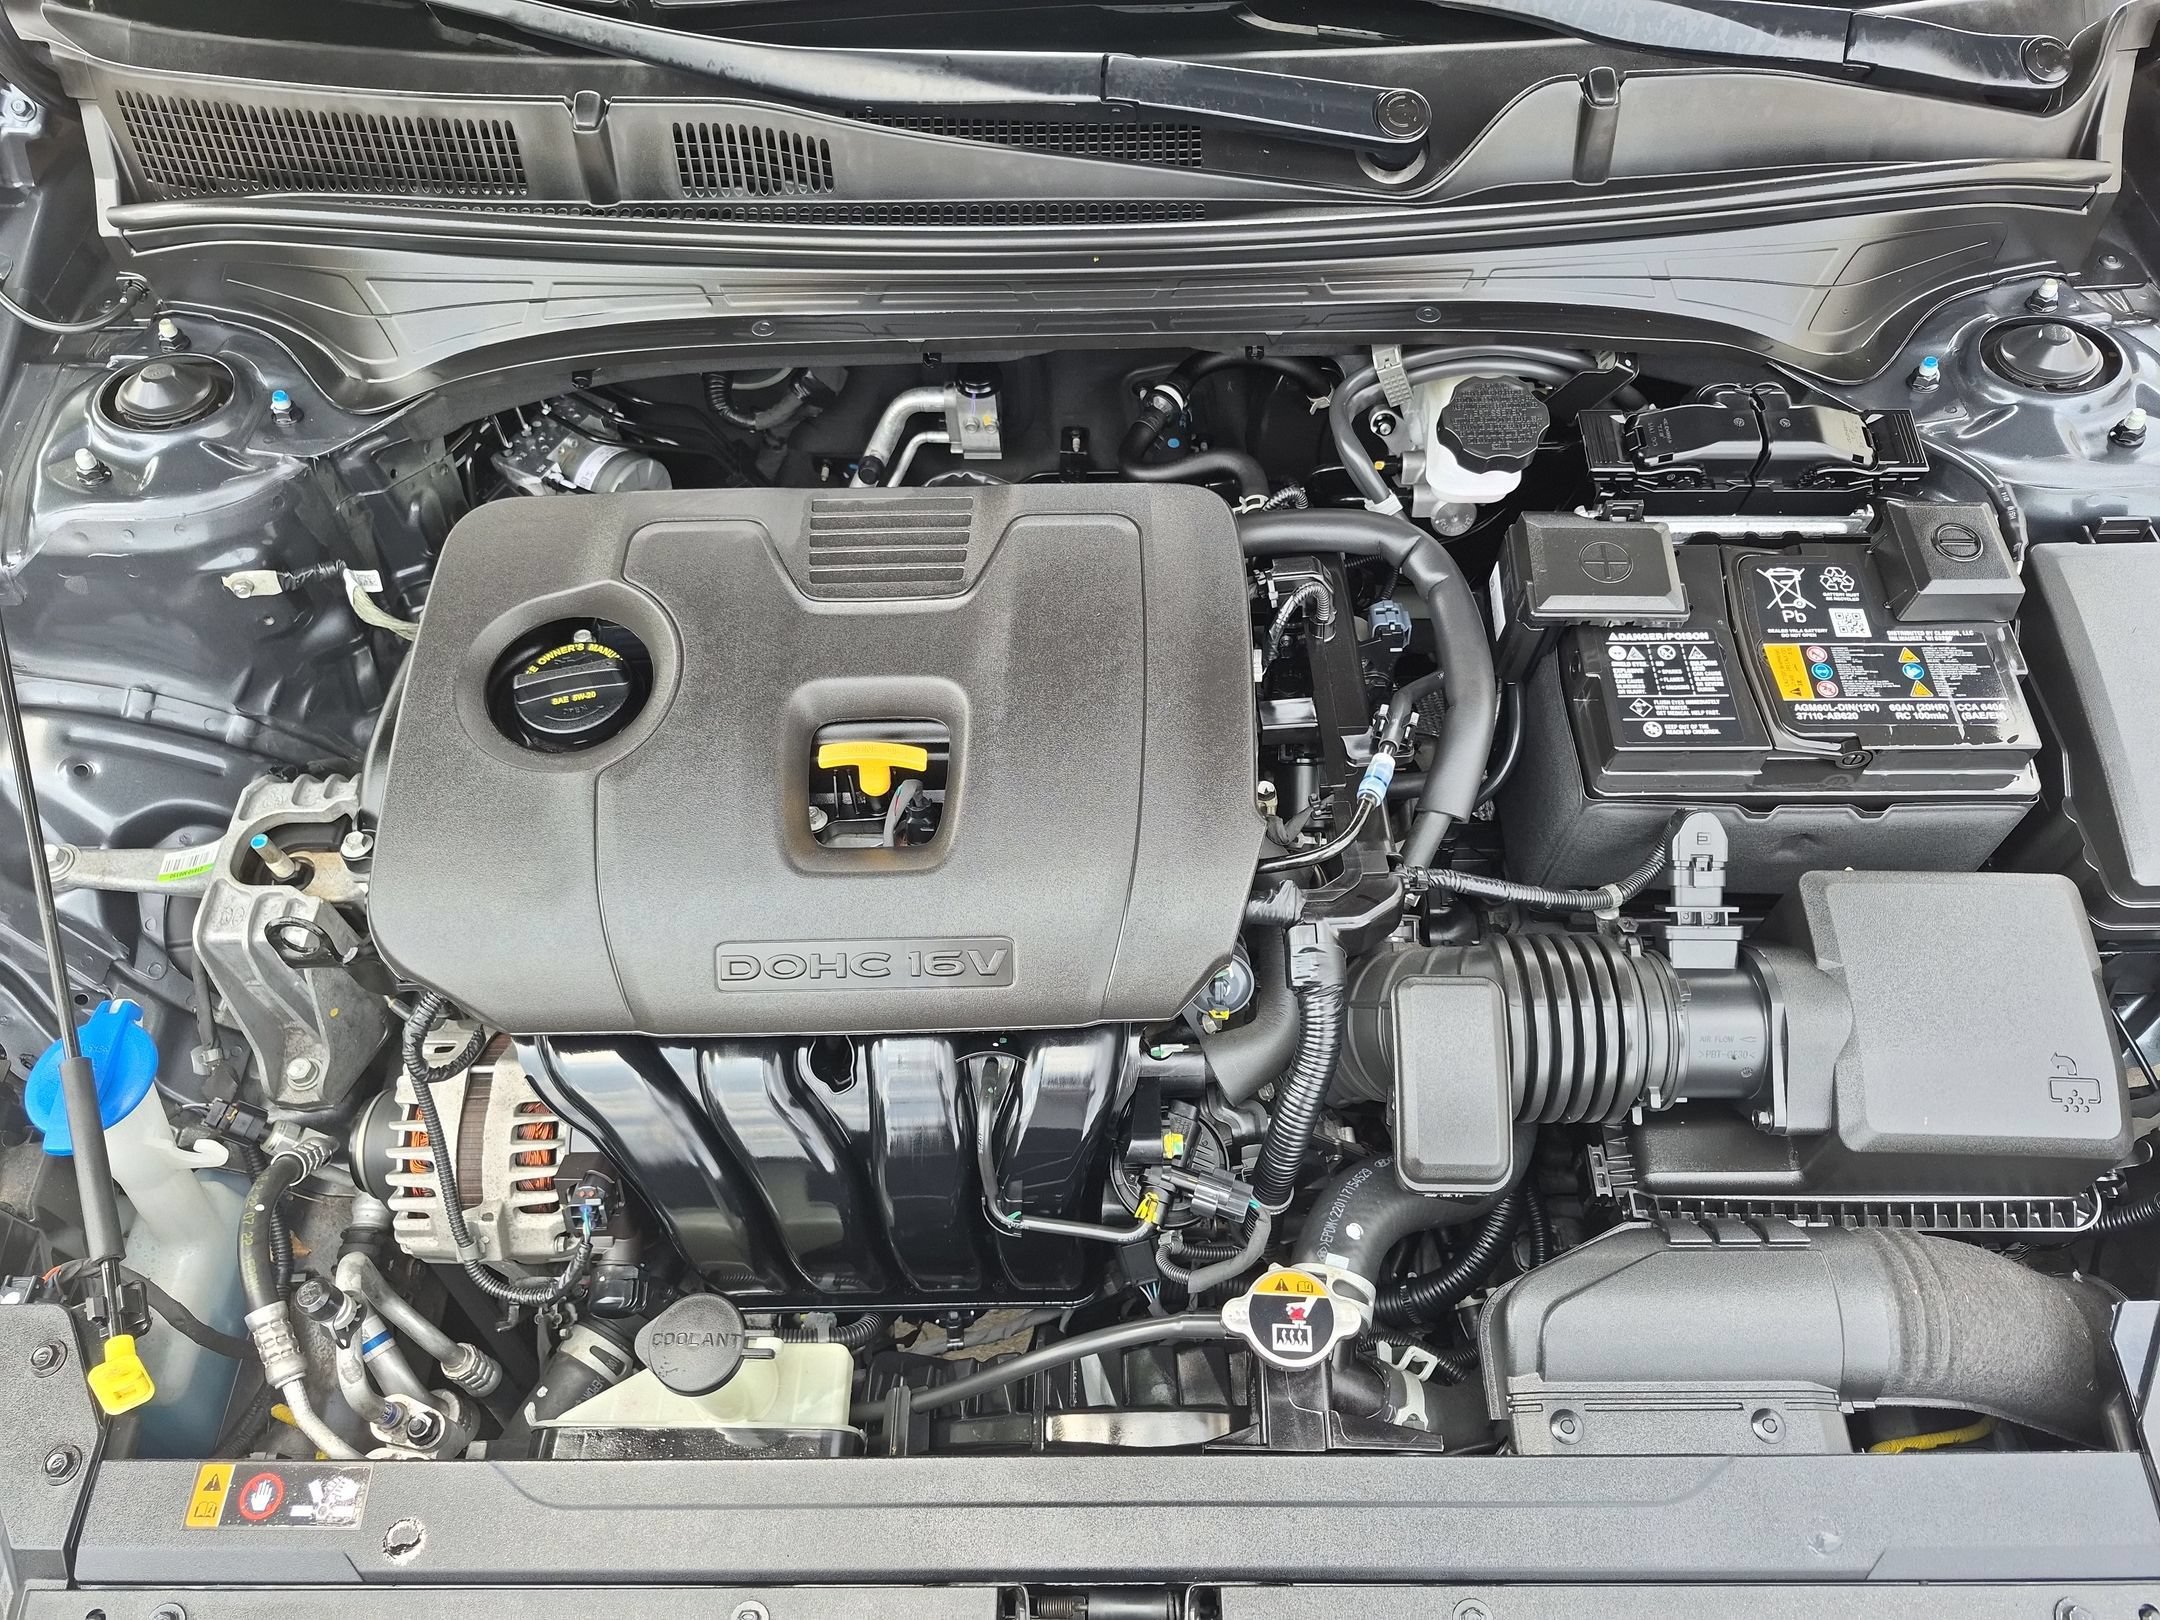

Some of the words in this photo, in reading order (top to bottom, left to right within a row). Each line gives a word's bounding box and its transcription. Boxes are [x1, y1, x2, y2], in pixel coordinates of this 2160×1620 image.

[1782, 610, 1807, 623] Pb
[1618, 632, 1709, 641] DANGER/POISON
[537, 643, 585, 666] OWNER'S
[587, 643, 624, 661] MANU
[551, 695, 570, 706] SAE
[571, 691, 597, 704] 5W-20
[1794, 703, 1880, 713] AGM60L-DIN(12V)
[1888, 703, 1915, 711] 60Ah
[1916, 703, 1950, 713] (20HR)
[1956, 703, 1980, 711] CCA
[1895, 711, 1912, 720] RC
[1912, 711, 1949, 720] 100min
[720, 951, 892, 981] DOHC
[907, 947, 1009, 977] 16V
[1698, 1035, 1713, 1044] AIR
[1713, 1035, 1736, 1043] FLOW
[651, 1332, 743, 1349] COOLANT
